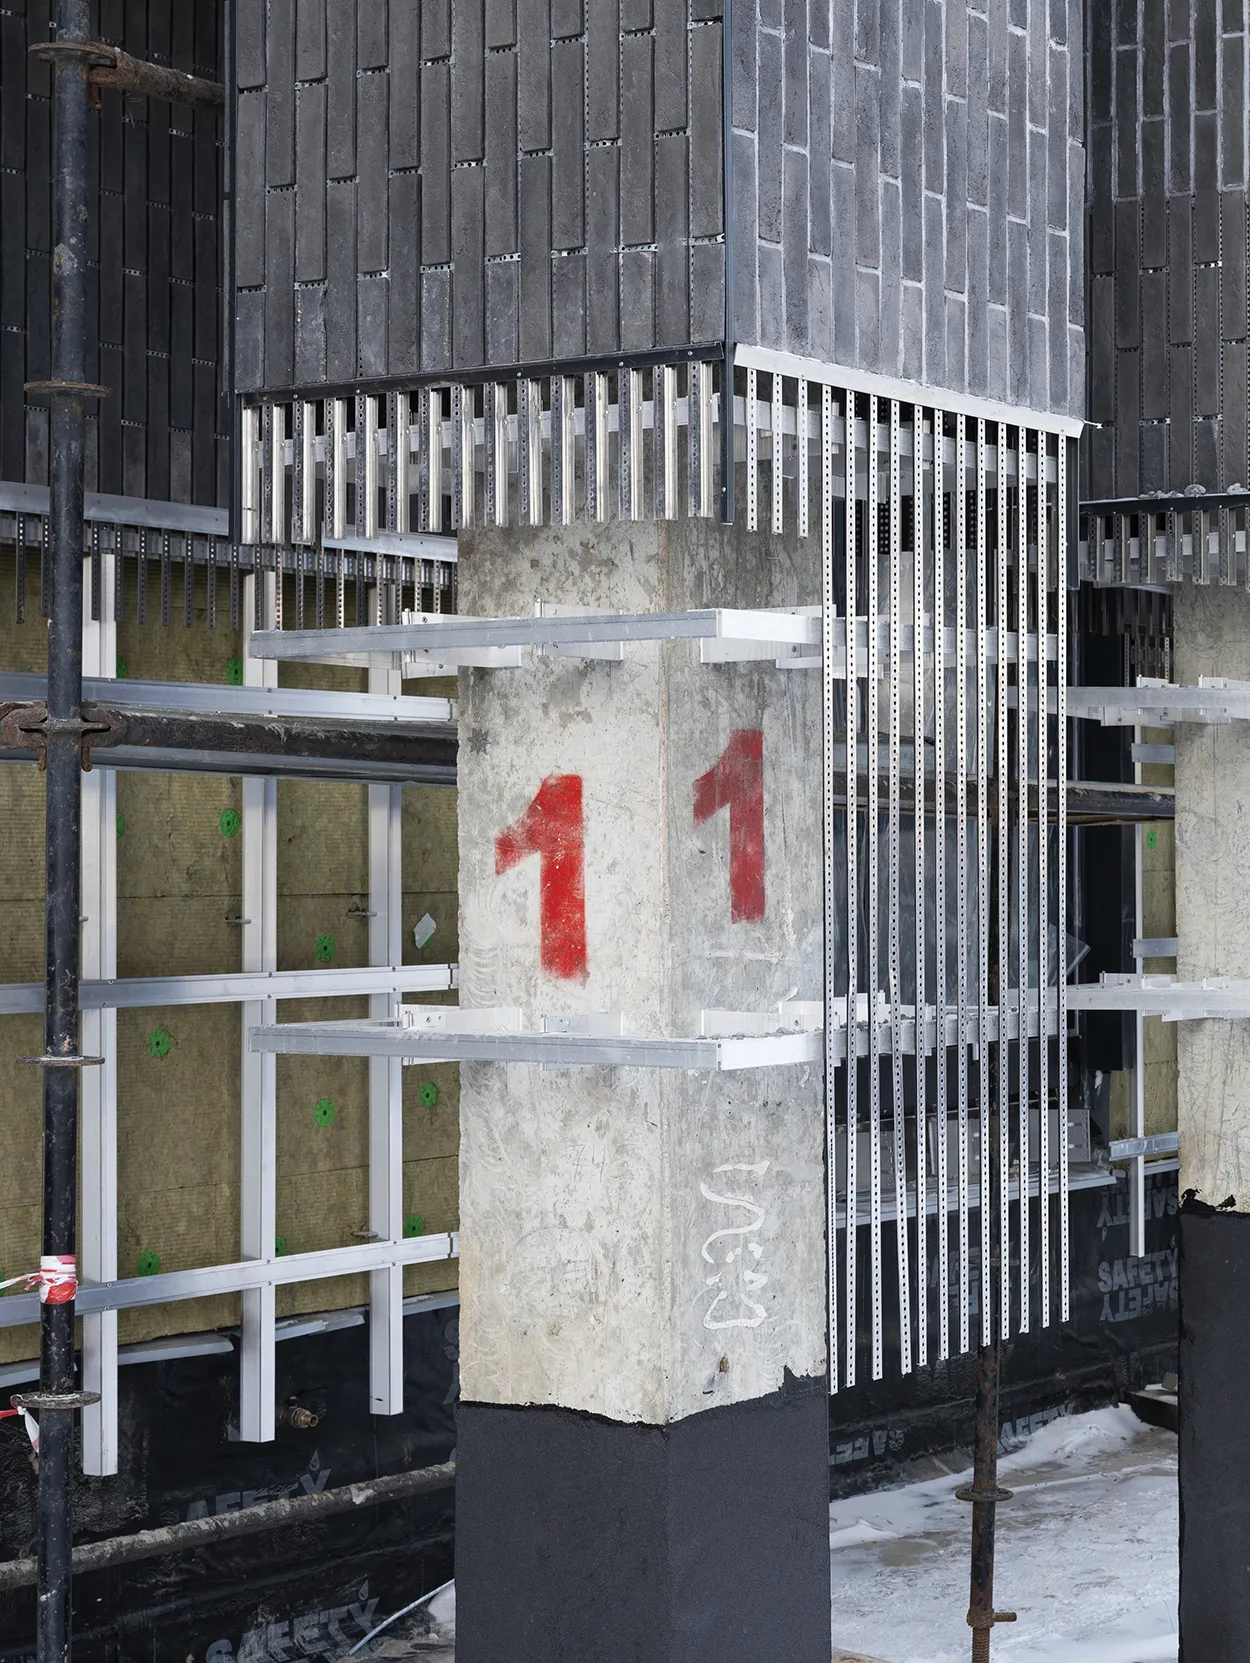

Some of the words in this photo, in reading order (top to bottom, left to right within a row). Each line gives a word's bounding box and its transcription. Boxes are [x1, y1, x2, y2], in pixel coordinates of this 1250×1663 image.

[495, 773, 588, 982] 1
[693, 728, 765, 924] 1
[1096, 1186, 1178, 1228] SAFTY
[1097, 1247, 1178, 1293] SAFETY
